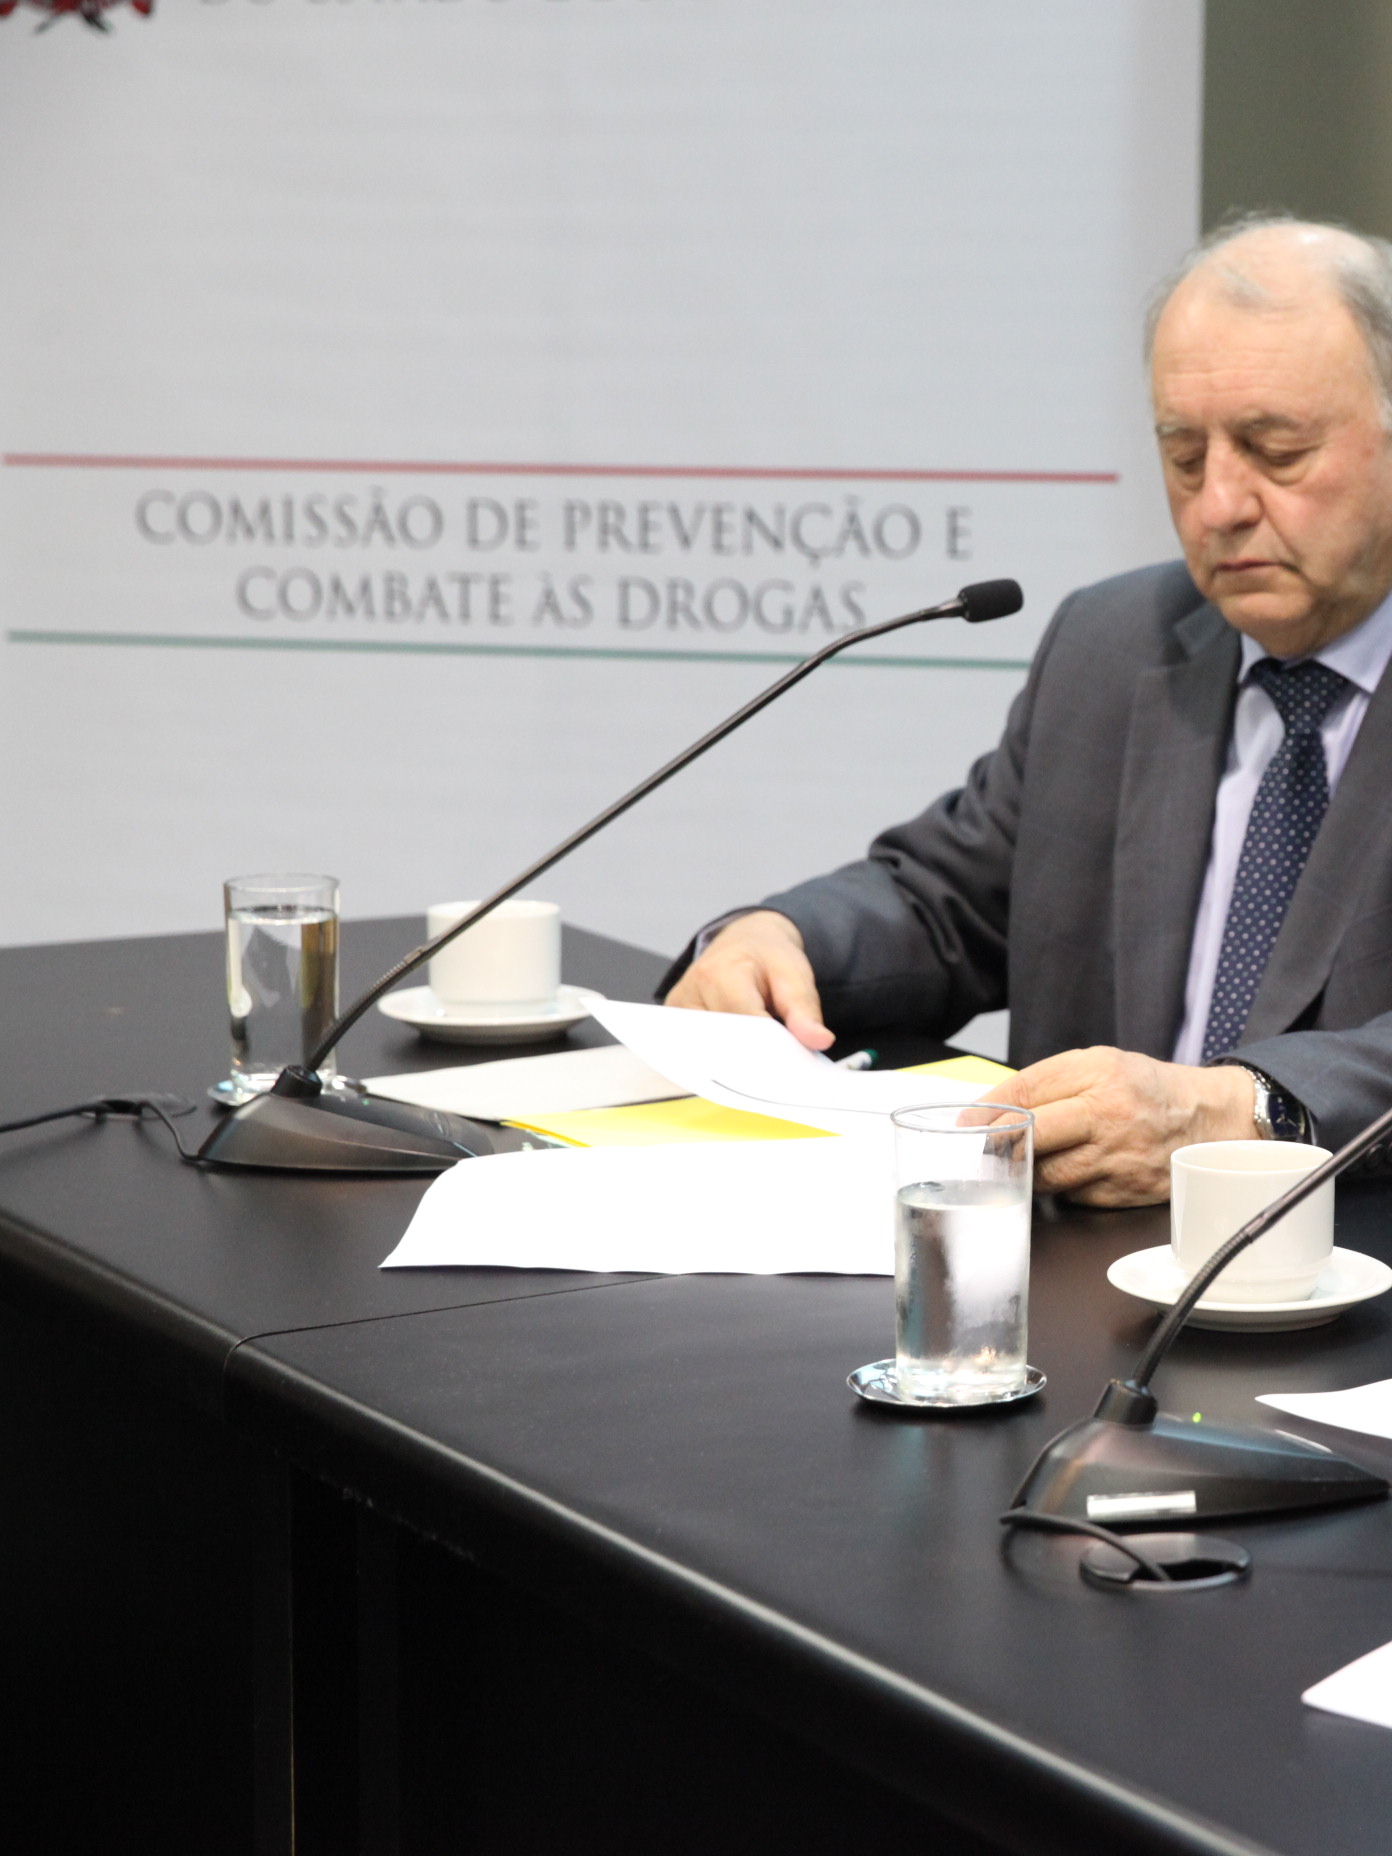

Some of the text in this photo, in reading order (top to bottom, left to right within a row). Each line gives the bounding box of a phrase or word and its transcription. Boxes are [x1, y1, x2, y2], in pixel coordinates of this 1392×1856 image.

[135, 485, 974, 567] COMISSÃO DE PREVENÇÃO E
[235, 564, 867, 634] COMBATE ÀS DROGAS
